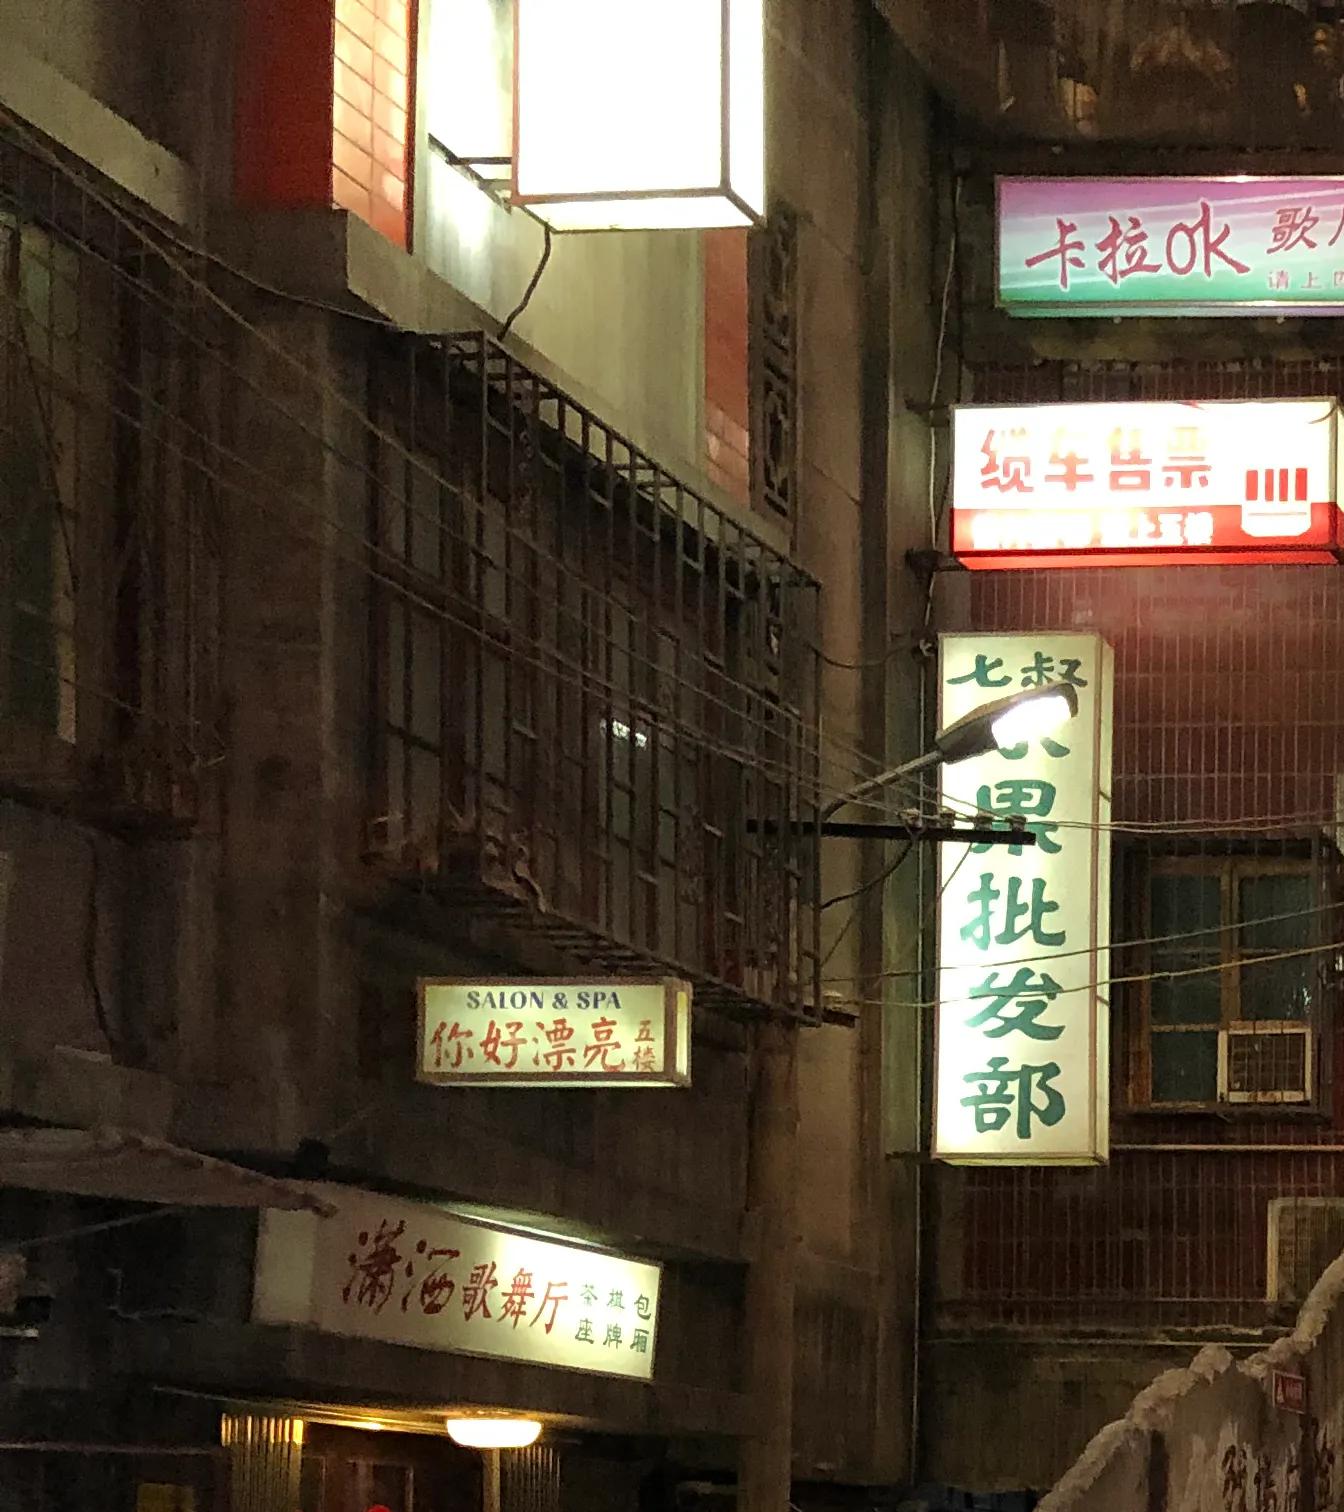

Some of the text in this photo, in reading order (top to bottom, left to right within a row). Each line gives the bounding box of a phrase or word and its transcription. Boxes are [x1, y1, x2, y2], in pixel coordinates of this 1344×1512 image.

[980, 427, 1212, 493] 缆车售票
[466, 990, 622, 1010] SALON & SPA
[430, 1016, 627, 1074] 你好漂亮
[632, 1019, 656, 1072] 五楼
